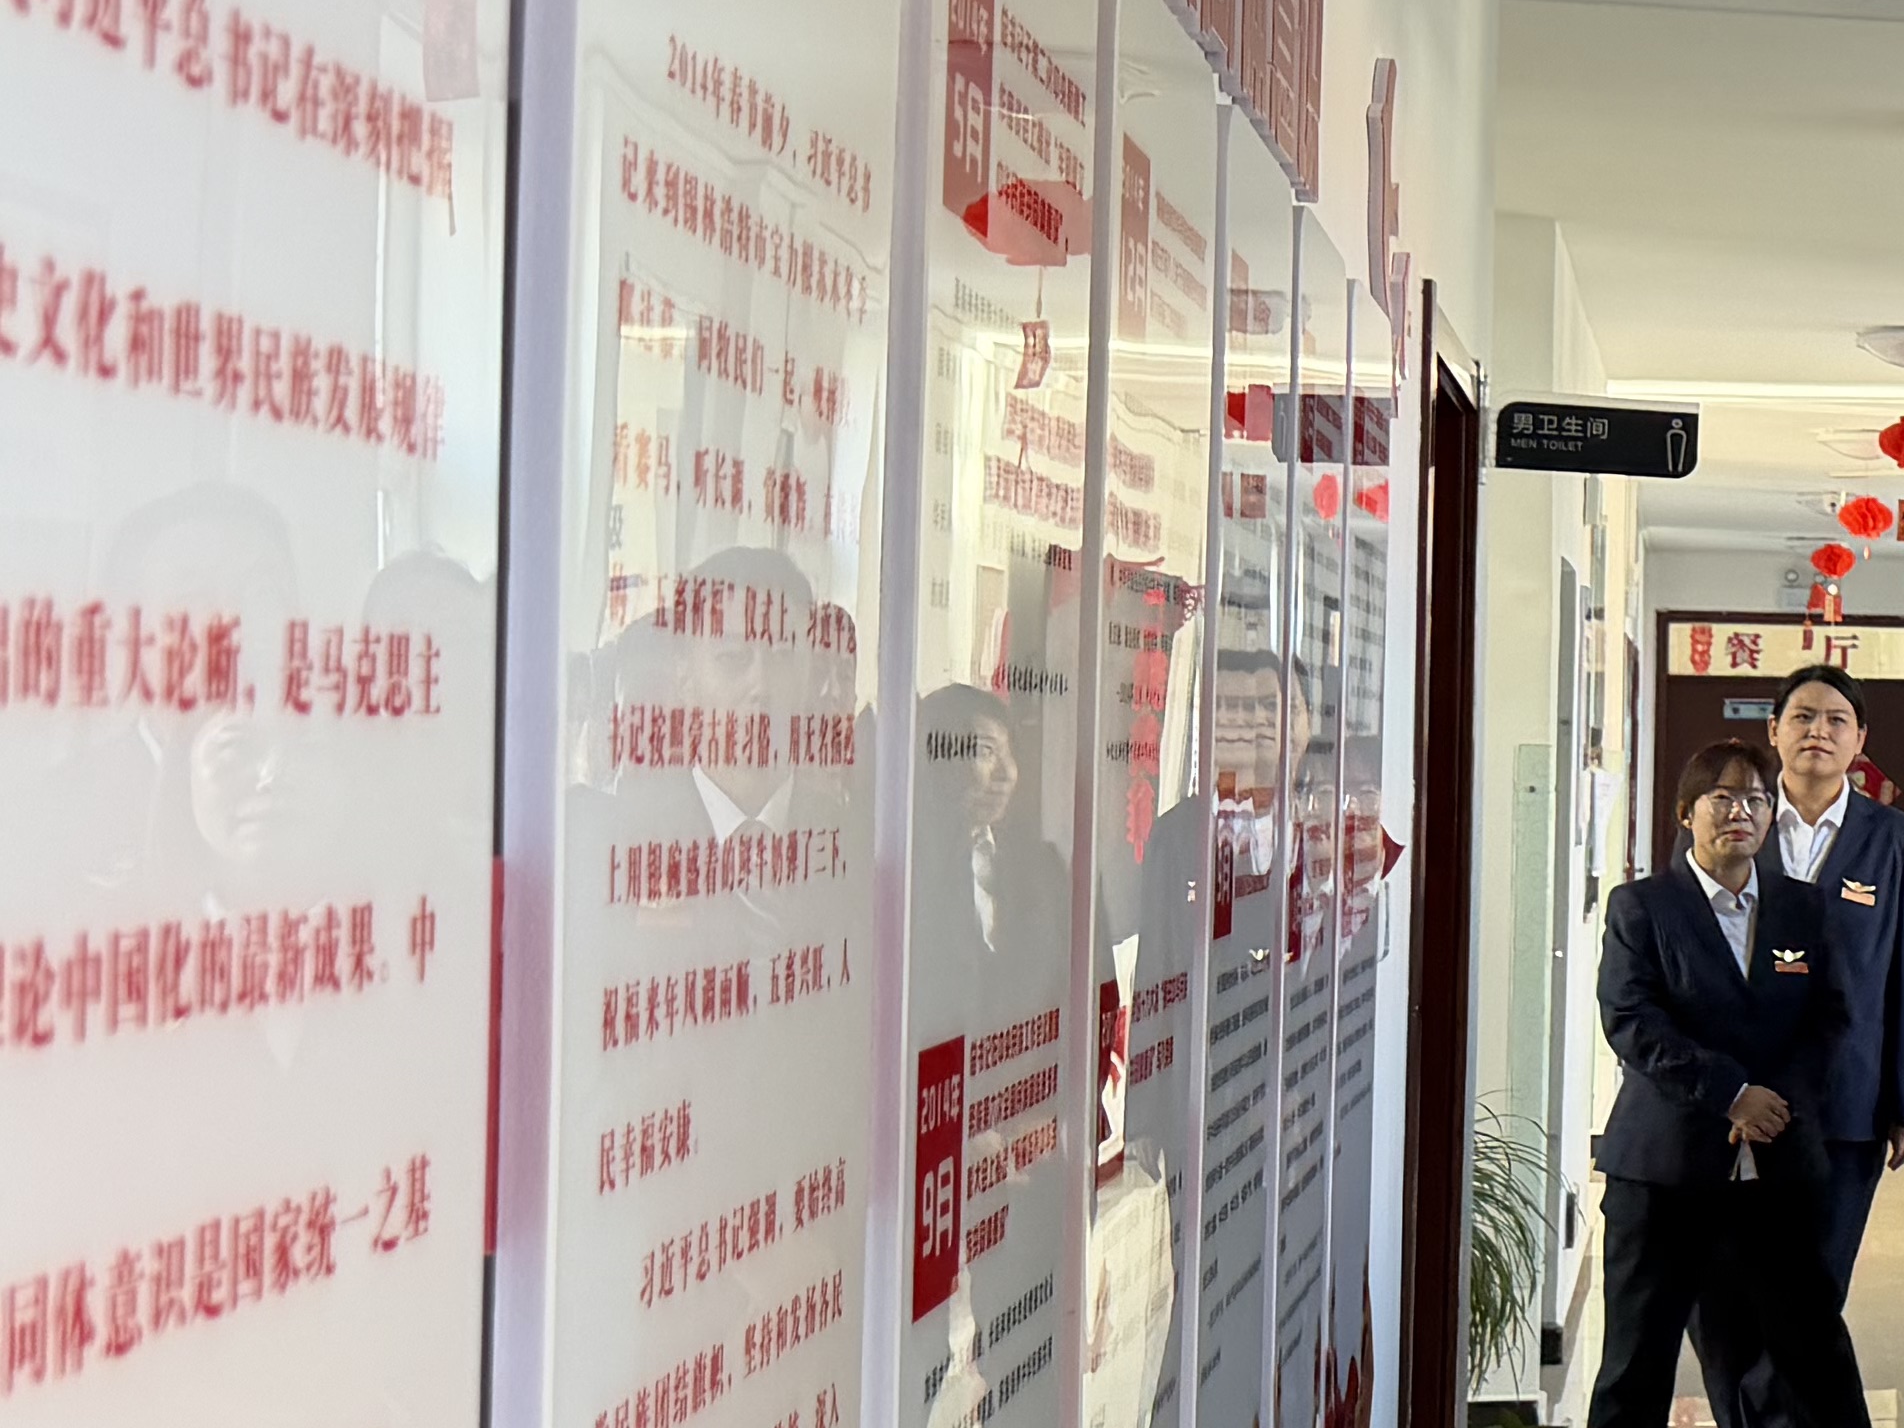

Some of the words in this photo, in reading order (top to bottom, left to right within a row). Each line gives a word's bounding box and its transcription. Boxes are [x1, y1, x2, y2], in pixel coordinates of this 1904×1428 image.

[668, 35, 872, 214] 2014年春节前夕，习近平总书
[953, 73, 983, 184] 5月
[1511, 438, 1537, 449] MEN
[1542, 440, 1583, 451] TOILET
[1512, 413, 1608, 439] 男卫生间
[0, 596, 441, 717] 的重大论断，是马克思主
[0, 894, 436, 1049] 论中国化的最新成果。中
[921, 1074, 961, 1134] 2014年
[923, 1155, 954, 1258] 9月
